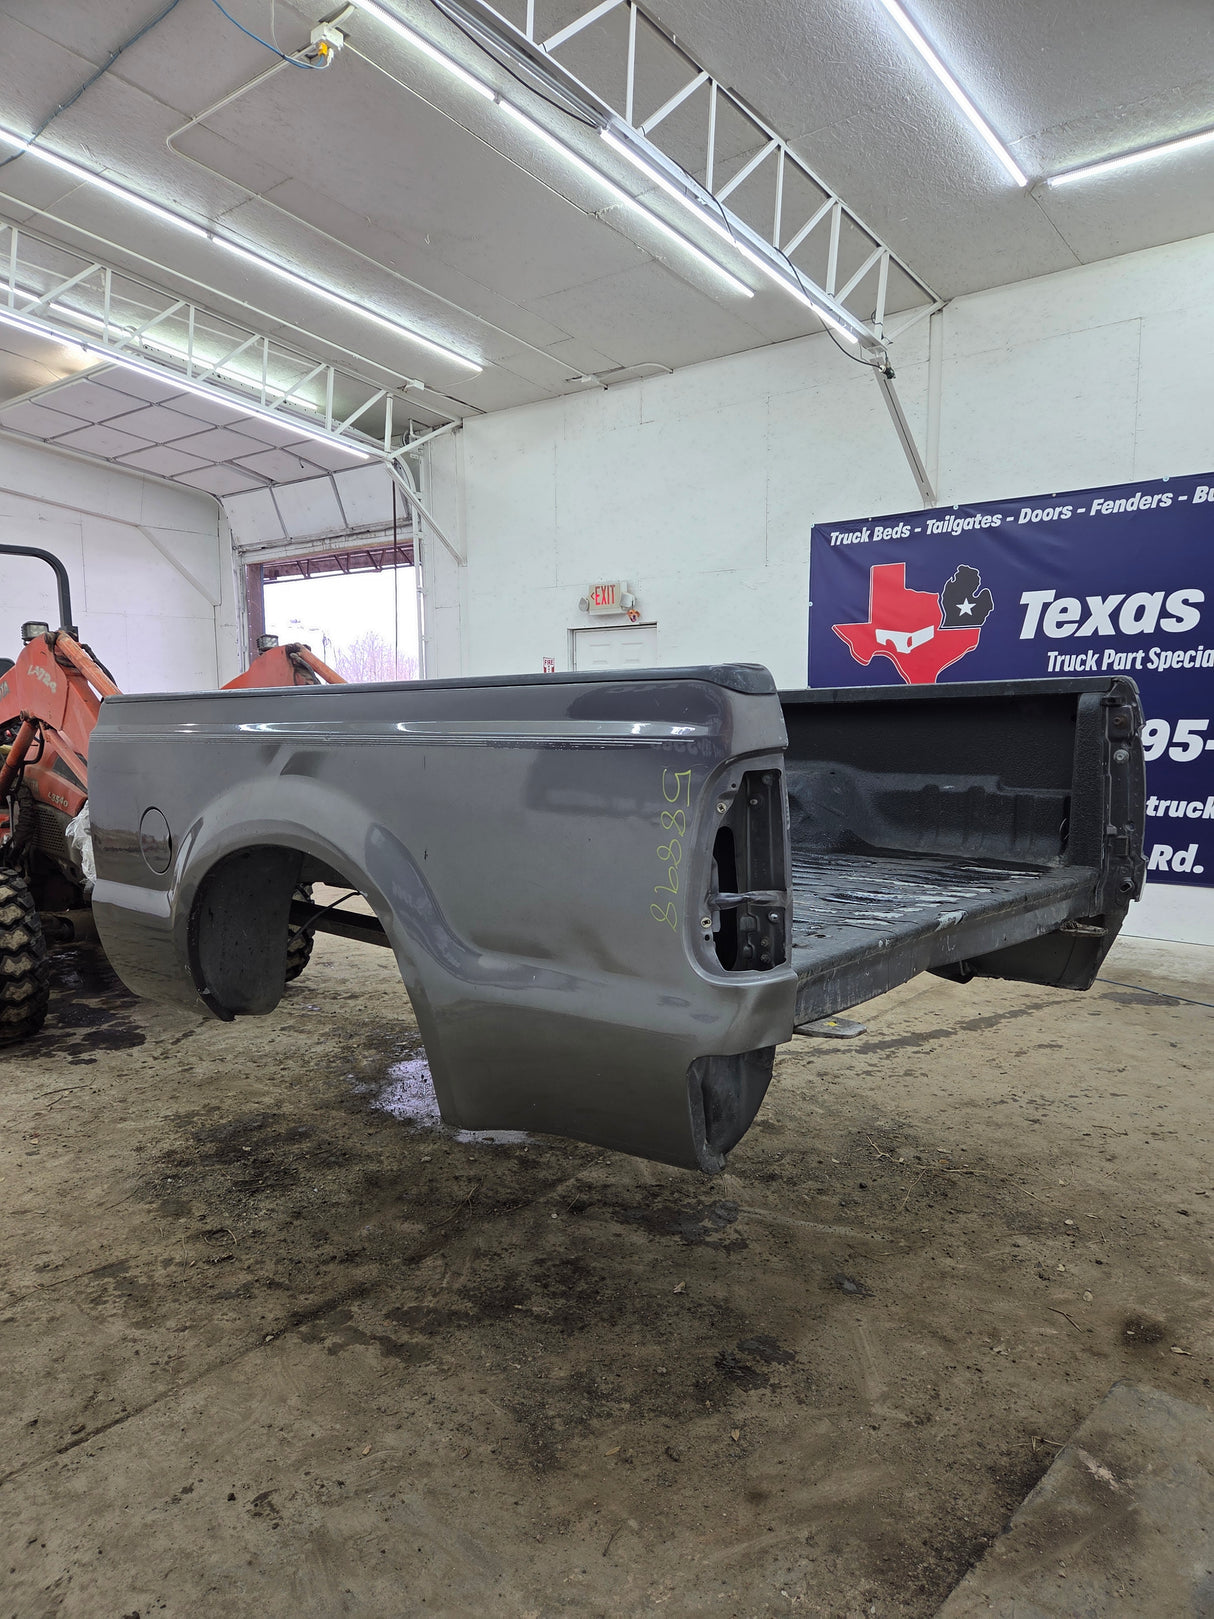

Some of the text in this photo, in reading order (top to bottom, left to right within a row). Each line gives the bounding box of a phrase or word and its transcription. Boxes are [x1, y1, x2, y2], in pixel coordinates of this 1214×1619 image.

[830, 527, 871, 546] Truck
[873, 523, 911, 541] Beds
[926, 513, 1002, 536] Tailgates
[1018, 505, 1073, 524] Doors
[1089, 492, 1174, 516] Fenders
[595, 584, 616, 606] EXIT
[1019, 588, 1205, 639] Texas
[1047, 645, 1214, 672] Truck Part Specia
[1145, 796, 1214, 819] truck
[650, 768, 692, 932] 58898
[1147, 843, 1205, 874] Rd.
